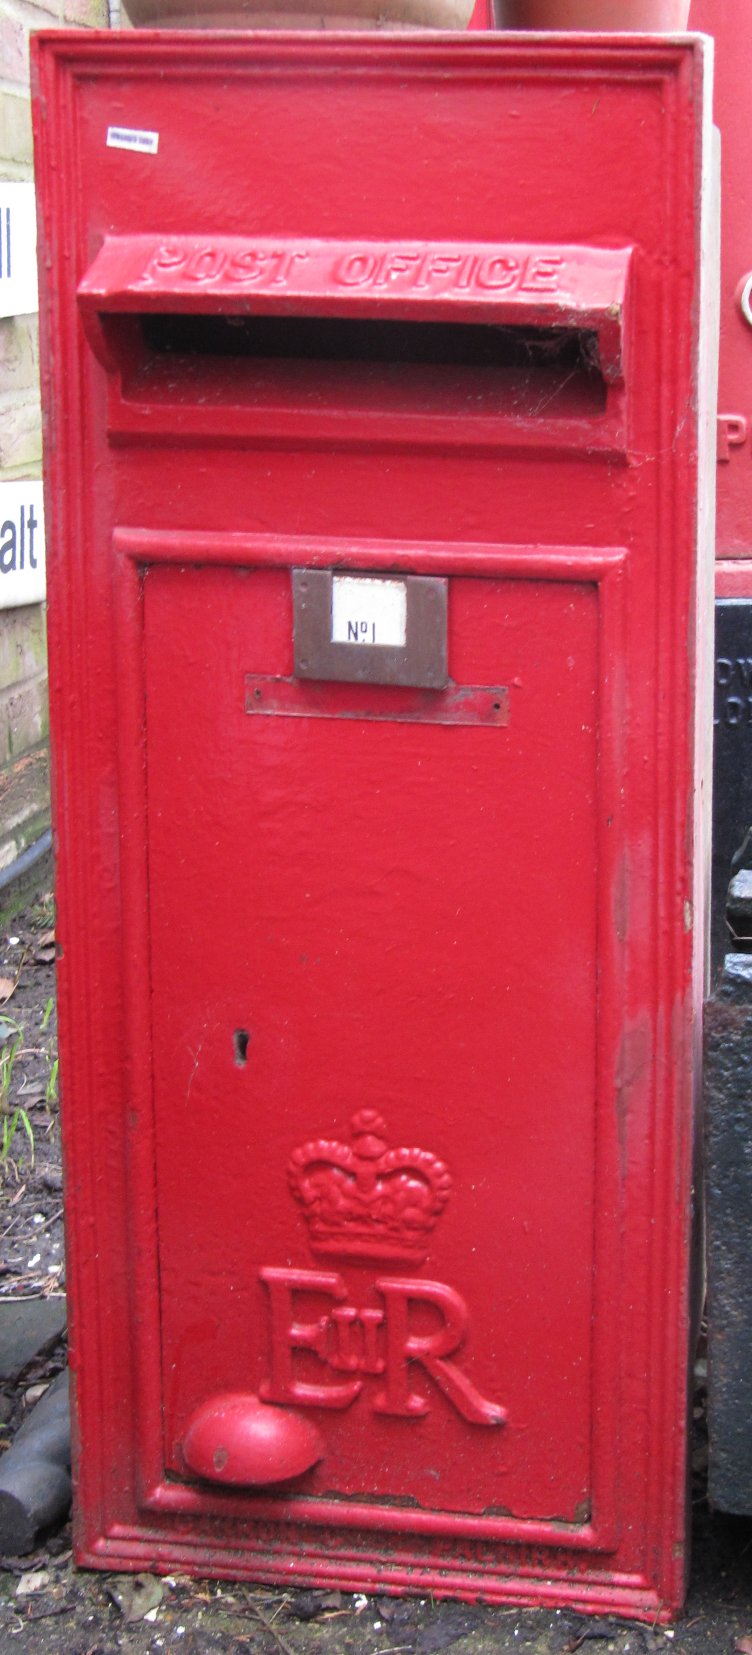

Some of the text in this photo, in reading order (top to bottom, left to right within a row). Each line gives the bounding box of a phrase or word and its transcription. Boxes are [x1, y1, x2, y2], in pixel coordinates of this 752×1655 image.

[143, 244, 566, 293] POST OFFICE
[0, 504, 38, 574] alt
